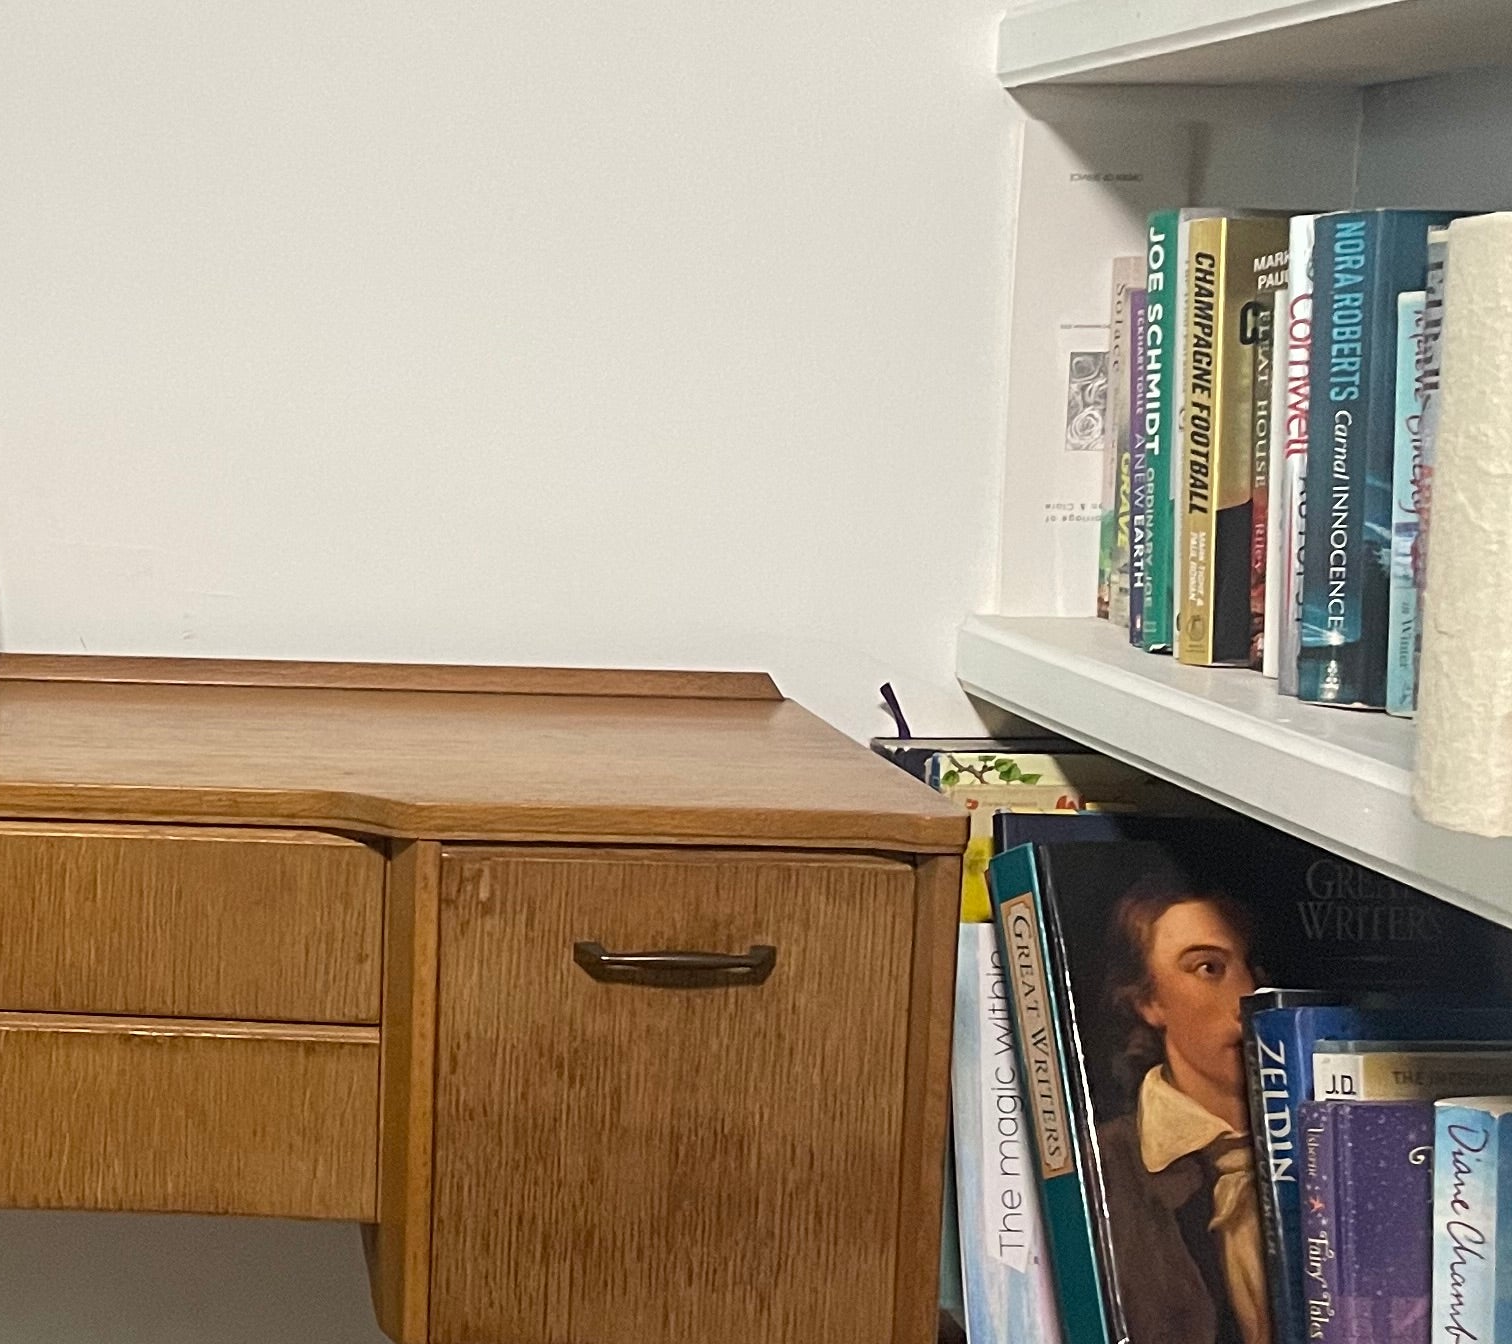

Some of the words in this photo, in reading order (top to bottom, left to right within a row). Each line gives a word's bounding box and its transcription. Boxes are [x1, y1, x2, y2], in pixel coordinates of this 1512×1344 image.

[1147, 227, 1165, 294] JOE
[1334, 221, 1366, 290] NORA
[1193, 252, 1216, 399] CHAMPAGNE
[1329, 290, 1362, 402] ROBERTS
[1145, 304, 1164, 456] SCHMIDT
[1133, 453, 1146, 508] NEW
[1134, 433, 1146, 450] A
[1189, 405, 1210, 515] FOOTBALL
[1330, 410, 1352, 480] Carnal
[1132, 513, 1145, 589] EARTH
[1327, 485, 1349, 633] INNOCENCE
[998, 1062, 1024, 1182] magic
[1032, 1027, 1062, 1159] WRITERS
[1257, 1036, 1295, 1182] ZELDIN
[1448, 1125, 1488, 1214] Diane
[1000, 1190, 1024, 1256] The
